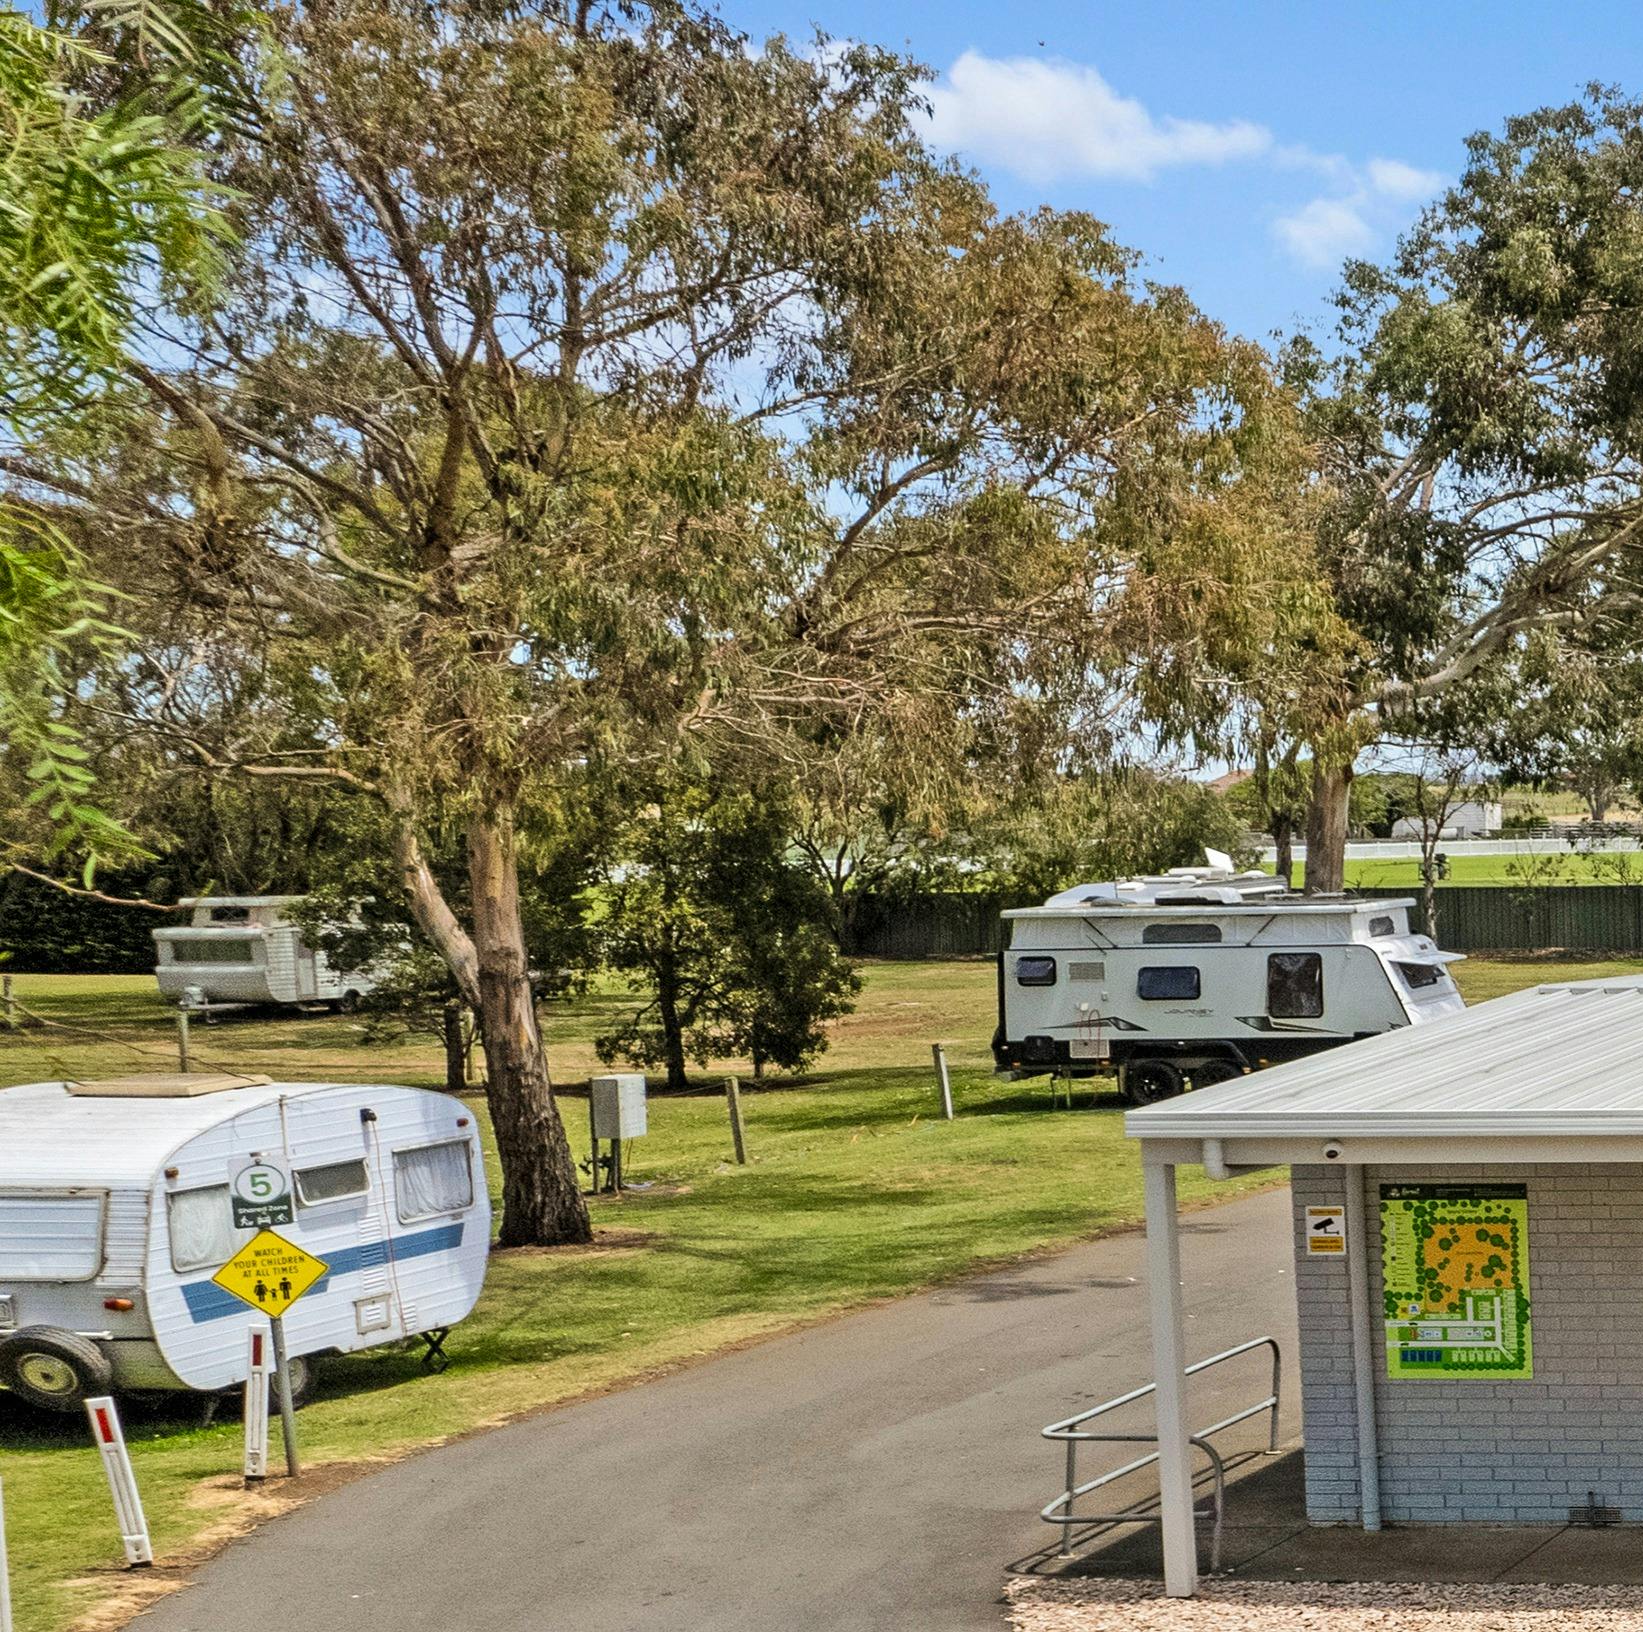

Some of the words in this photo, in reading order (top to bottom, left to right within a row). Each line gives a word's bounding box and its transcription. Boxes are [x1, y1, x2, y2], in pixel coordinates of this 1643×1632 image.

[250, 1173, 272, 1197] 5
[237, 1205, 267, 1214] Shared
[268, 1204, 288, 1212] Zone
[254, 1248, 283, 1257] WATCH
[233, 1261, 257, 1270] YOUR
[260, 1256, 305, 1267] CHILDREN
[243, 1270, 252, 1278] AT
[255, 1269, 270, 1277] ALL
[273, 1265, 299, 1275] TIMES
